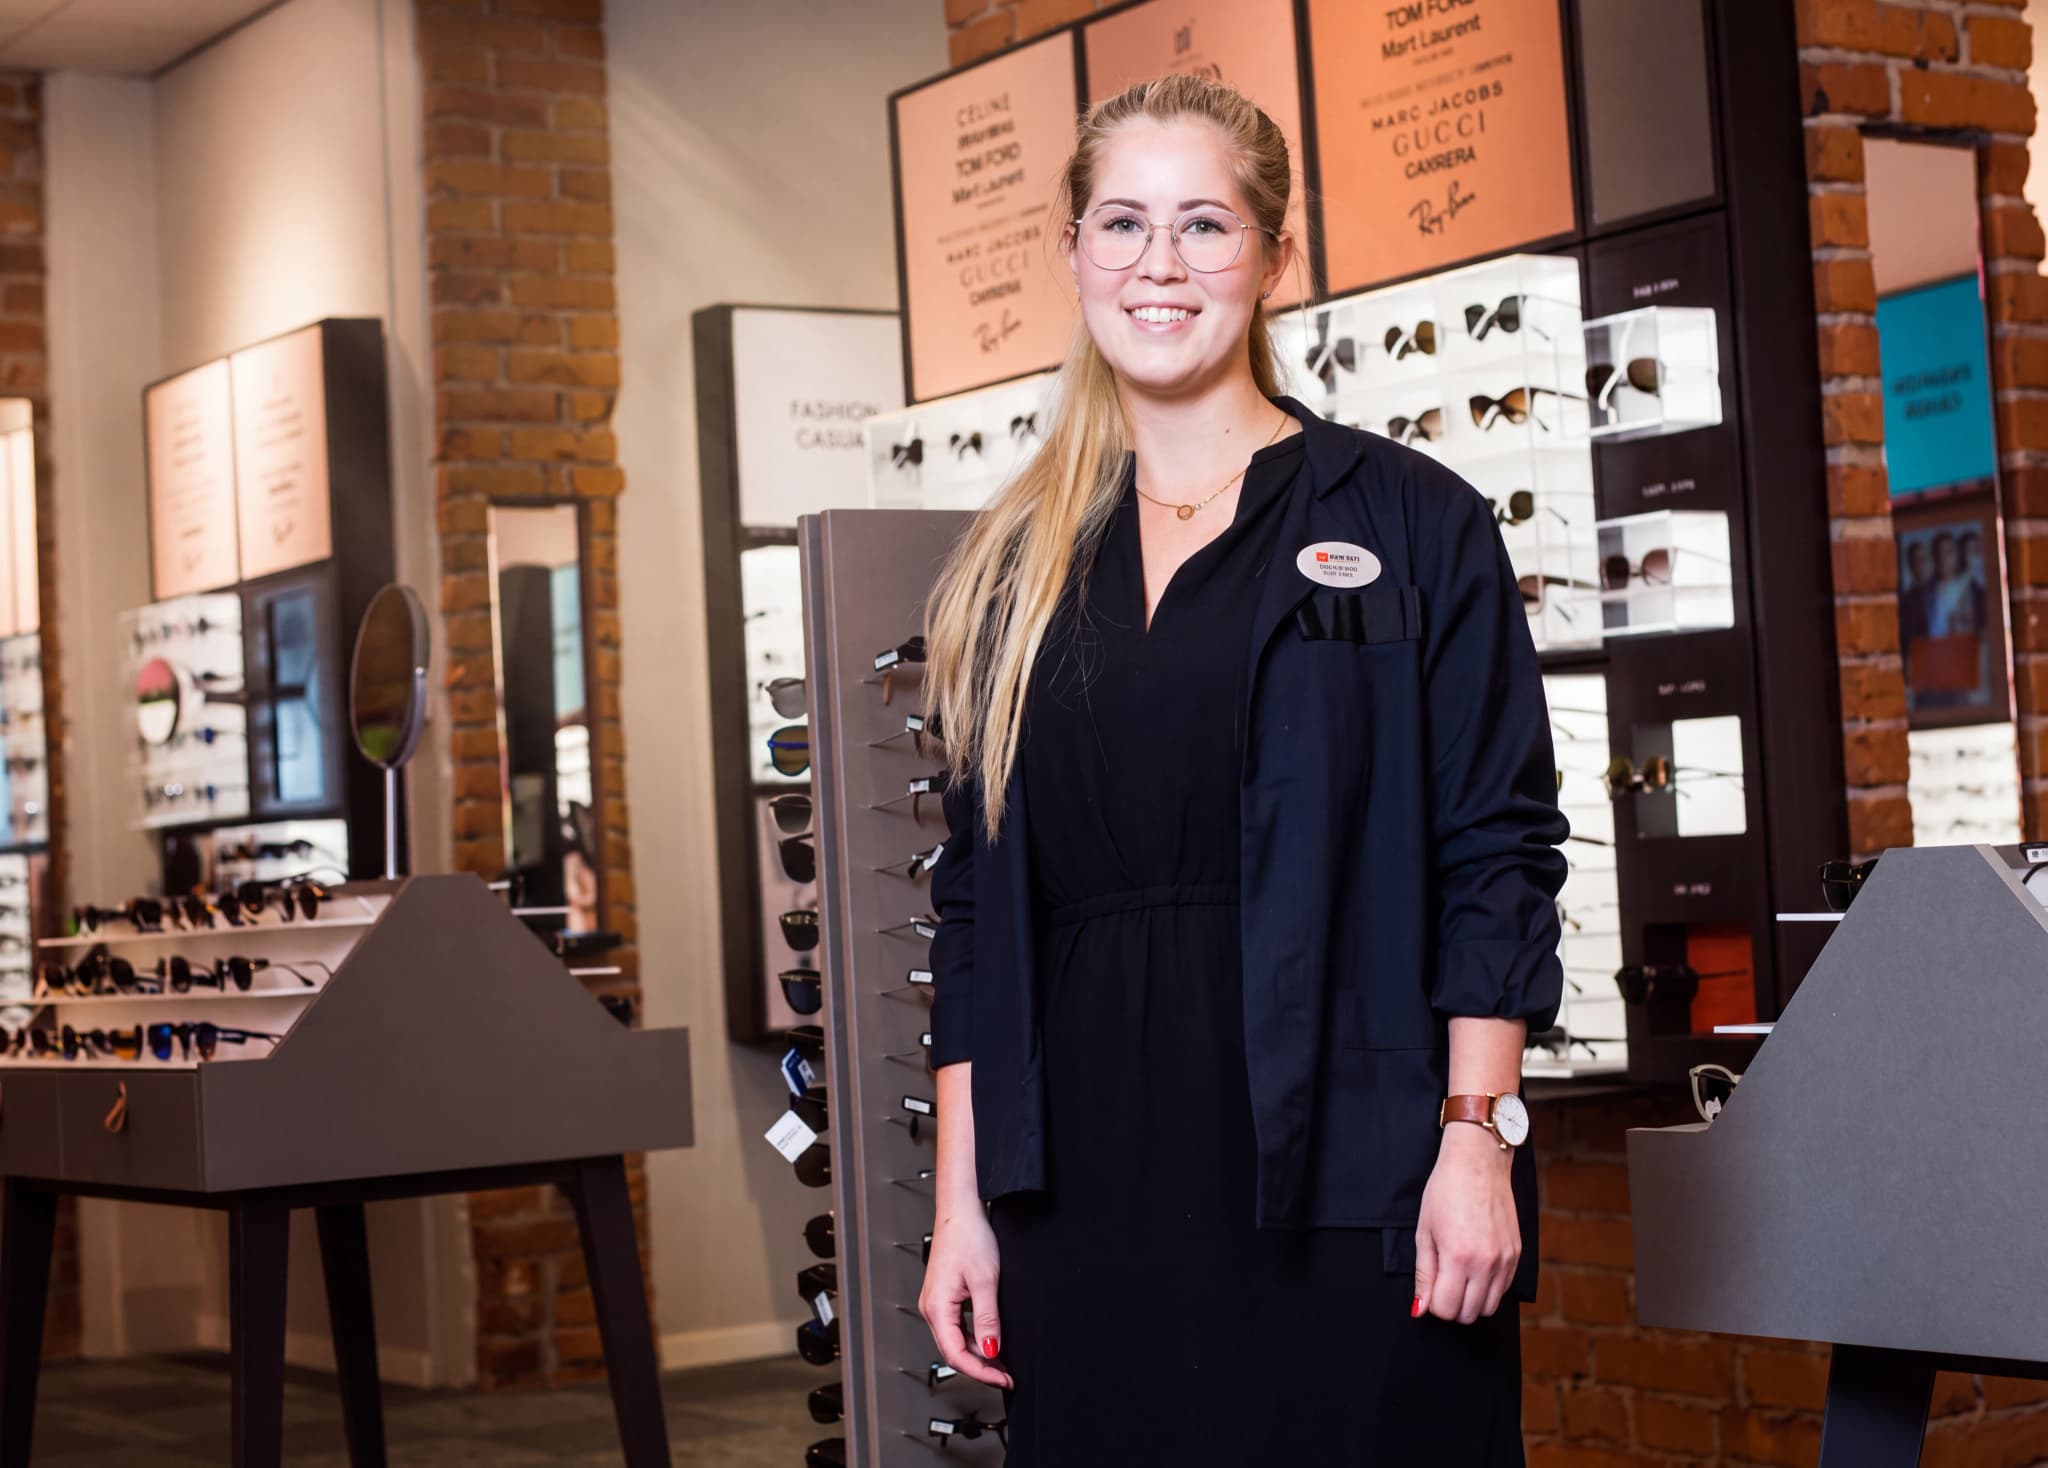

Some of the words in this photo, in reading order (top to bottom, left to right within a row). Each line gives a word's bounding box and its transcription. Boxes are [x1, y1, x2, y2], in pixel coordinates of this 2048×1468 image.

[1381, 36, 1417, 62] Mart
[1420, 13, 1481, 48] Laurent
[1386, 1, 1423, 31] TOM
[1371, 105, 1421, 132] MARC
[1428, 79, 1503, 117] JACOBS
[1392, 109, 1485, 157] GUCCI
[959, 248, 1029, 289] GUCCI
[795, 427, 865, 449] CASUA
